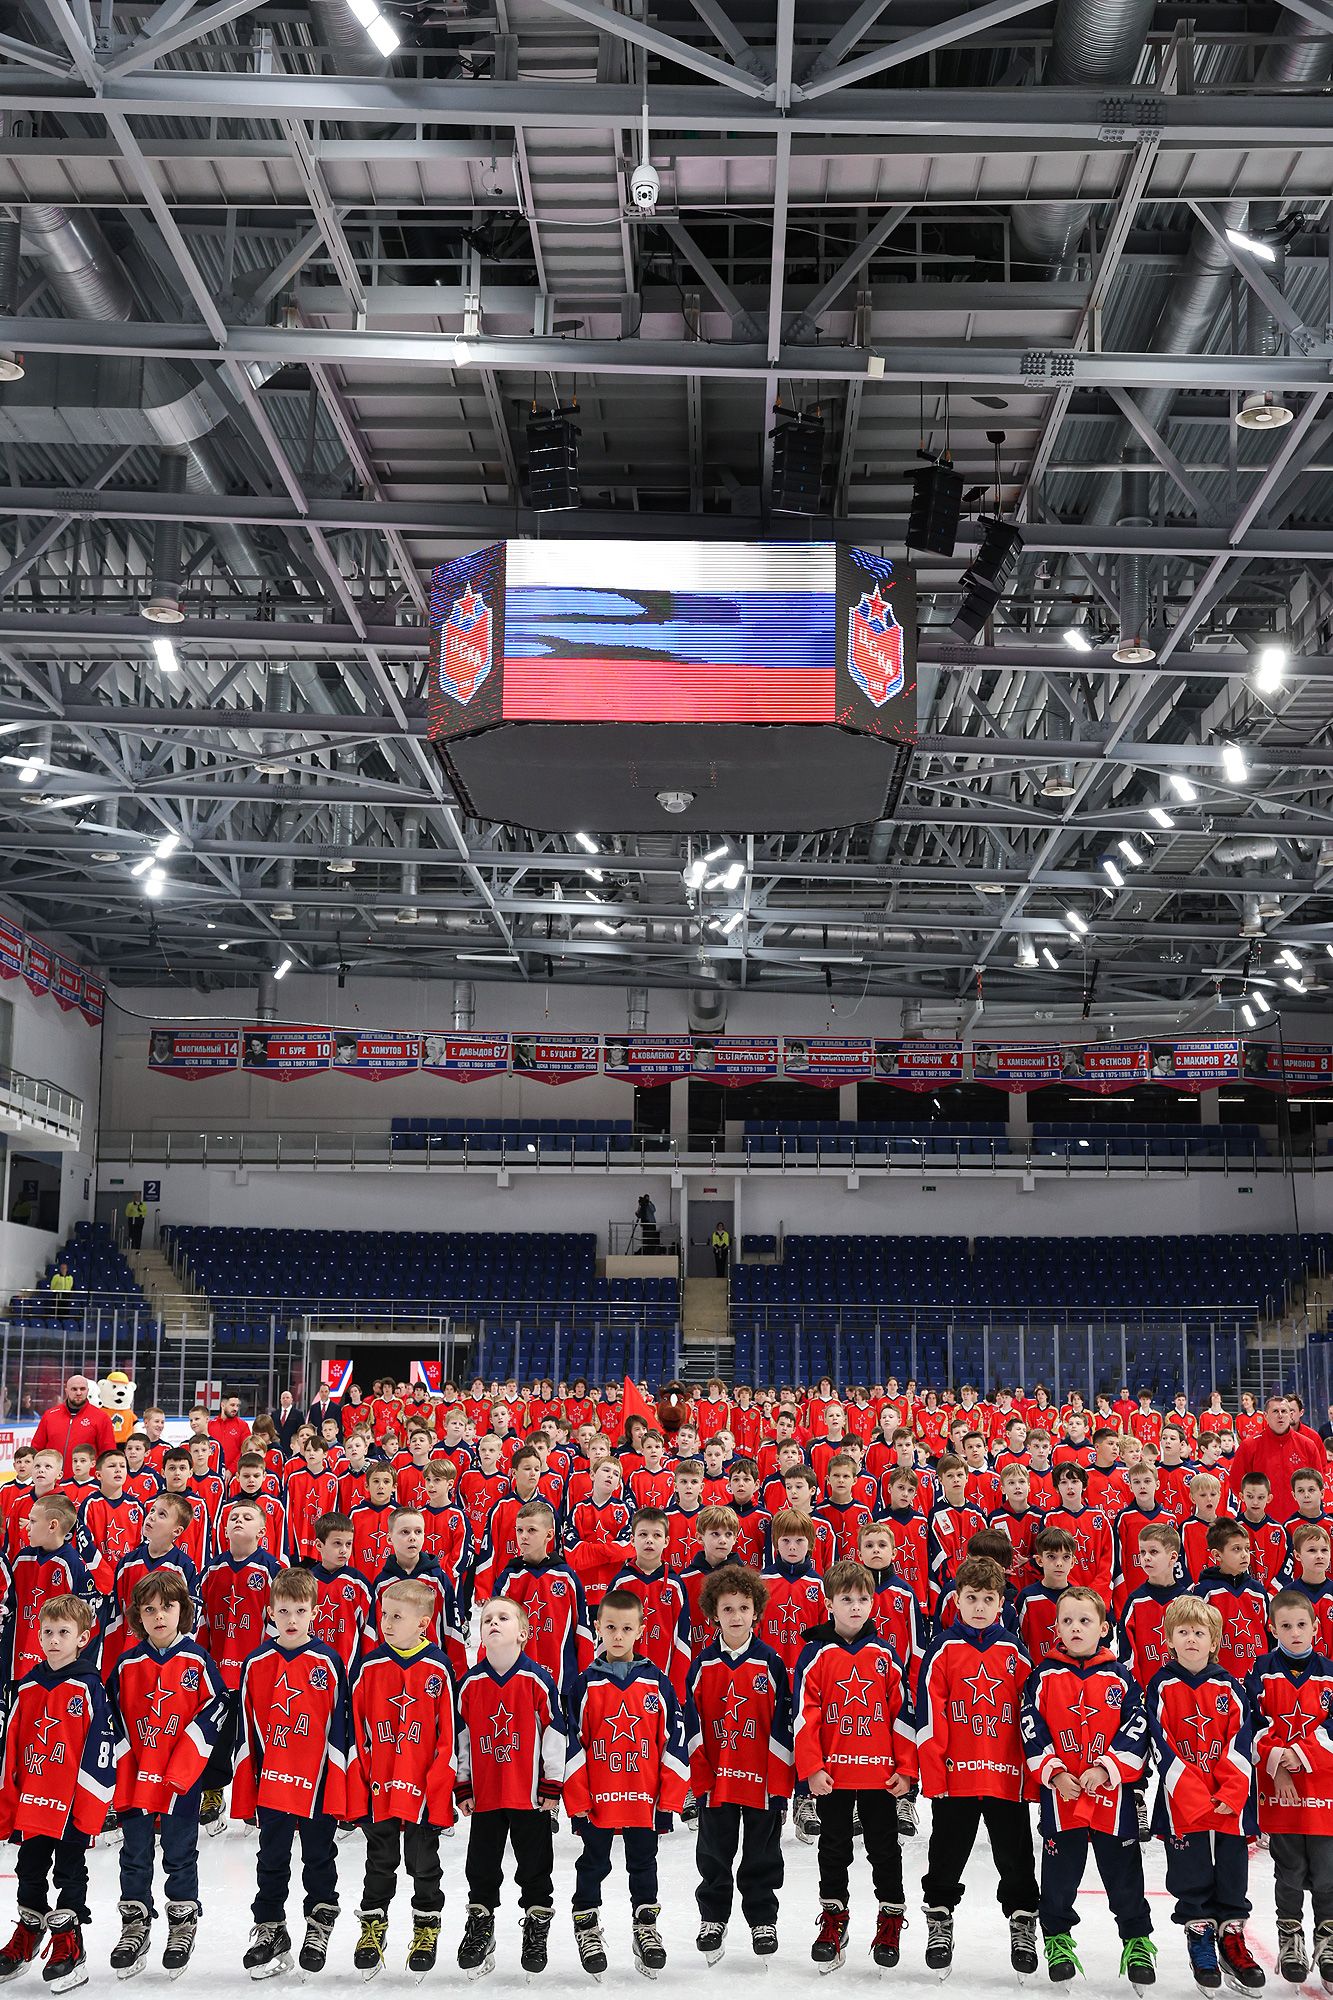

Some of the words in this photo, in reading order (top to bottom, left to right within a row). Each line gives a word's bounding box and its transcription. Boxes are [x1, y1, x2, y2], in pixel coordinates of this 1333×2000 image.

[224, 1042, 238, 1055] 14
[280, 1046, 287, 1055] П.
[289, 1046, 306, 1055] БУРЕ
[317, 1044, 330, 1056] 10
[362, 1046, 369, 1054] А.
[371, 1046, 402, 1054] ХОМУТОВ
[406, 1044, 418, 1056] 15
[452, 1048, 458, 1056] Е.
[459, 1048, 492, 1057] ДАВЫДОВ
[494, 1046, 507, 1058] 67
[541, 1050, 548, 1058] В.
[550, 1050, 576, 1058] БУЦАЕВ
[582, 1048, 596, 1060] 22
[632, 1051, 674, 1060] А.КОВАЛЕНКО
[678, 1050, 690, 1061] 26
[768, 1050, 774, 1062] 3
[862, 1051, 869, 1063] 6
[912, 1056, 942, 1064] КРАВЧУК
[950, 1054, 958, 1066] 4
[998, 1058, 1006, 1066] В.
[1007, 1056, 1044, 1066] КАМЕНСКИЙ
[1046, 1054, 1060, 1067] 13
[1090, 1058, 1098, 1066] В.
[1100, 1058, 1132, 1066] ФЕТИСОВ
[1138, 1054, 1146, 1067] 2
[1176, 1056, 1220, 1066] С.МАКАРОВ
[1224, 1054, 1238, 1066] 24
[1320, 1058, 1328, 1070] 8
[148, 1182, 156, 1194] 2
[215, 1613, 250, 1638] ЦКА
[1220, 1634, 1262, 1658] ЦСКА
[826, 1702, 884, 1736] ЦСКА
[952, 1700, 1013, 1737] ЦСКА
[136, 1714, 180, 1748] ЦКА
[480, 1732, 520, 1763] ЦСКА
[24, 1742, 66, 1776] ЦКА
[592, 1738, 649, 1772] ЦСКА
[1176, 1740, 1222, 1774] ЦКА
[957, 1758, 1020, 1776] РОСНЕФТЬ
[261, 1768, 312, 1790] НЕФТЬ
